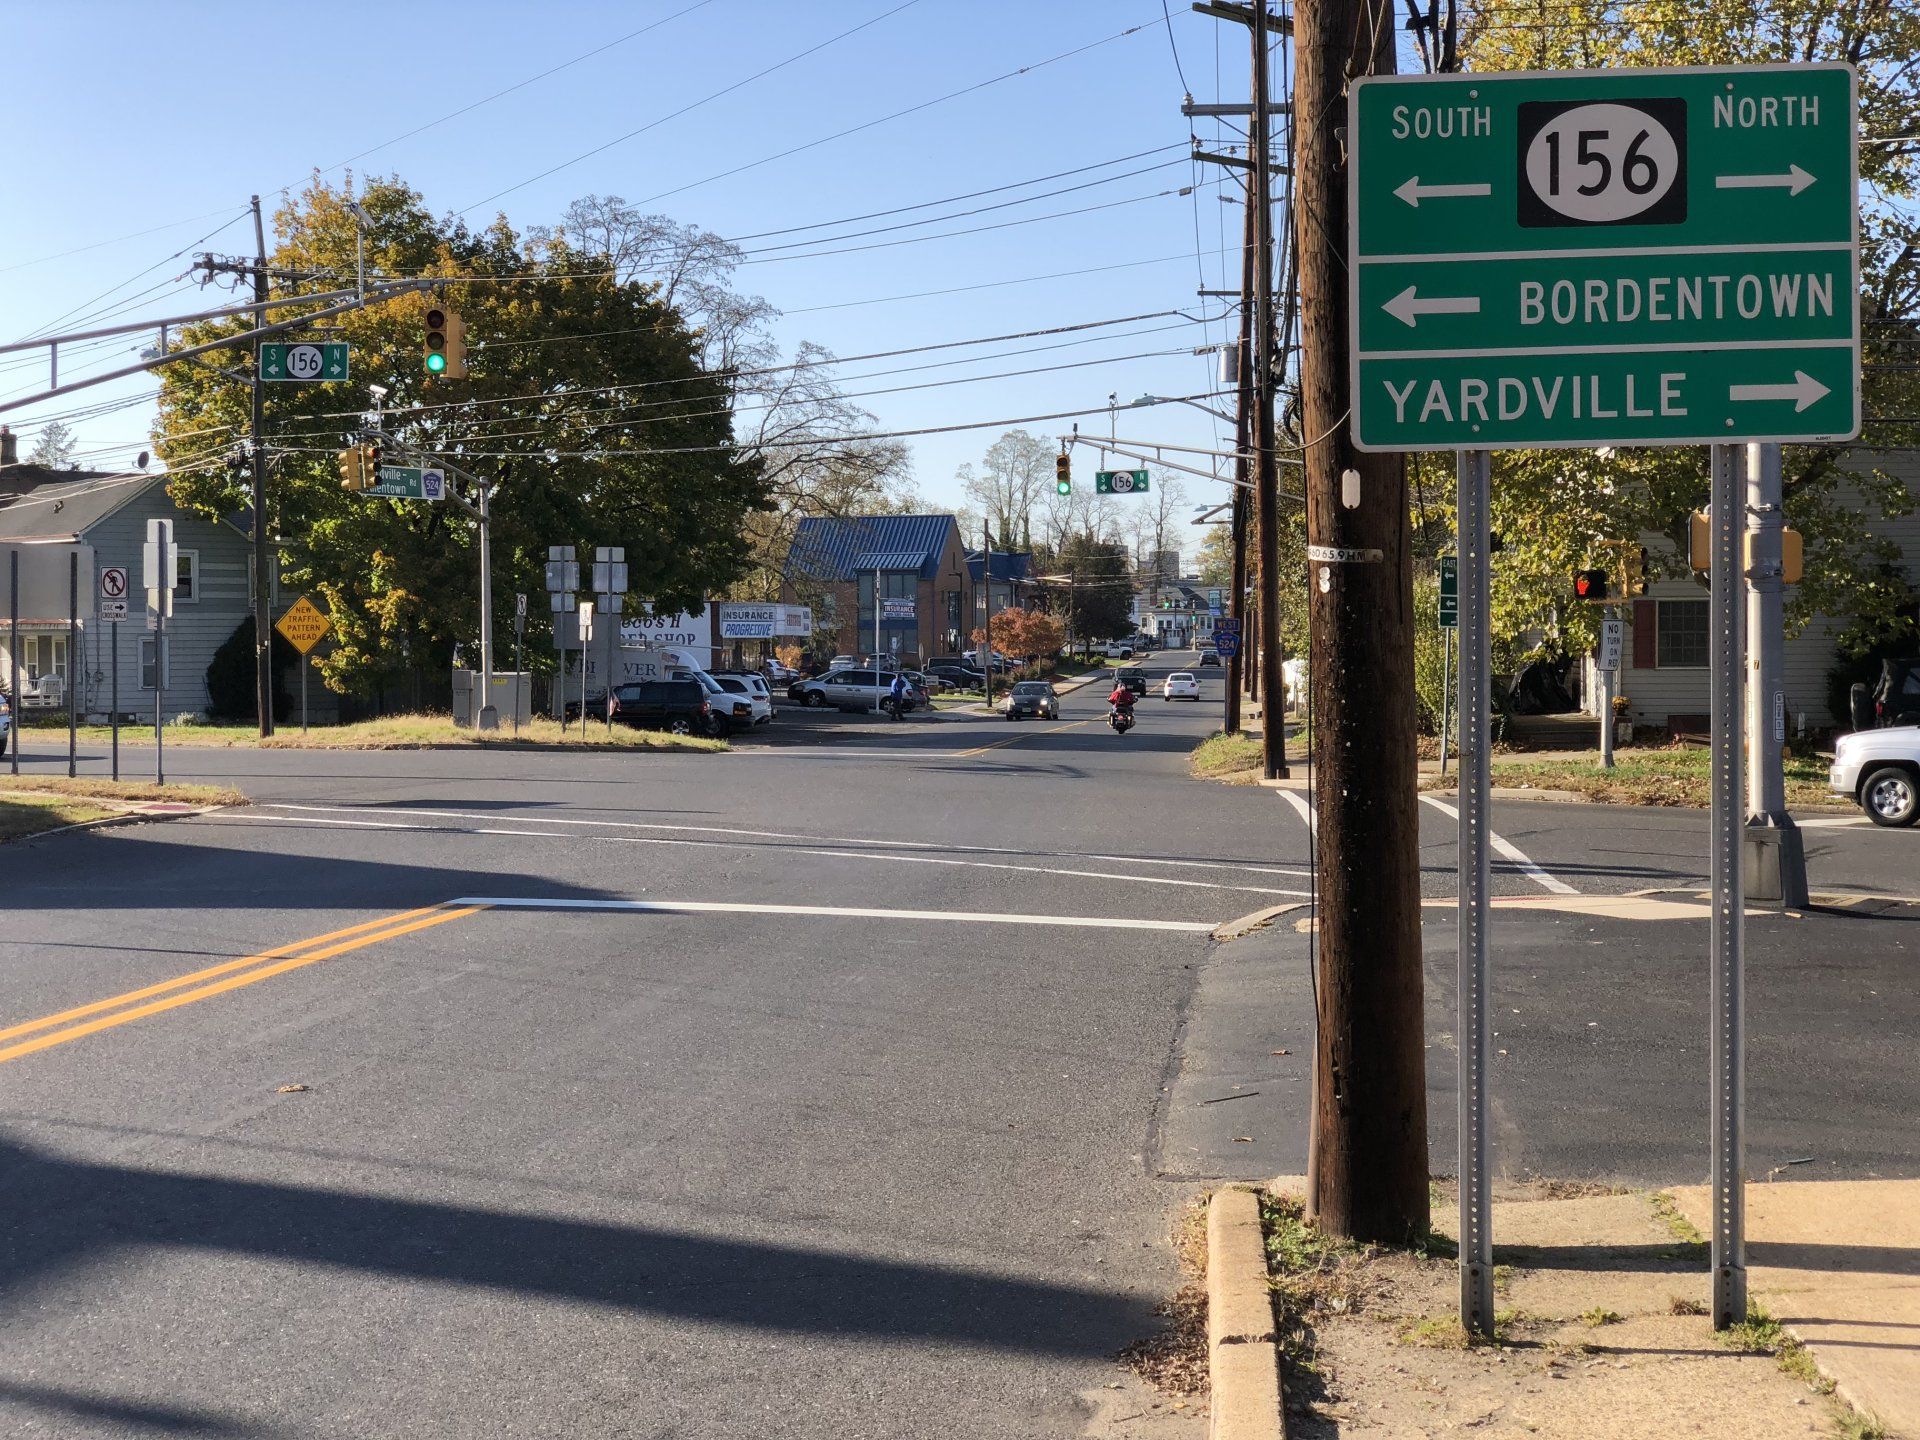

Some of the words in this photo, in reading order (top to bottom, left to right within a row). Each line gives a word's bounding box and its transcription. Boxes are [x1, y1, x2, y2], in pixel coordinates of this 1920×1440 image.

[1713, 94, 1820, 129] NORTH
[1391, 105, 1492, 139] SOUTH
[1545, 129, 1660, 197] 156
[1519, 272, 1834, 325] BORDENTOWN
[270, 348, 277, 360] S
[333, 348, 340, 360] N
[291, 352, 319, 372] 156
[1382, 371, 1688, 424] YARDVILLE
[379, 467, 401, 480] dville
[1101, 474, 1106, 483] S
[1140, 472, 1145, 480] N
[409, 478, 417, 487] Rd
[425, 480, 439, 490] 524
[1114, 476, 1131, 488] 156
[1443, 559, 1456, 568] EAST
[723, 611, 774, 620] INSURANCE
[725, 623, 772, 636] PROGRESSIVE
[1217, 620, 1236, 629] WEST
[1608, 624, 1619, 634] NO
[654, 633, 696, 646] SHOP
[1219, 639, 1235, 649] 524
[1607, 636, 1620, 645] TURN
[1610, 647, 1618, 656] ON
